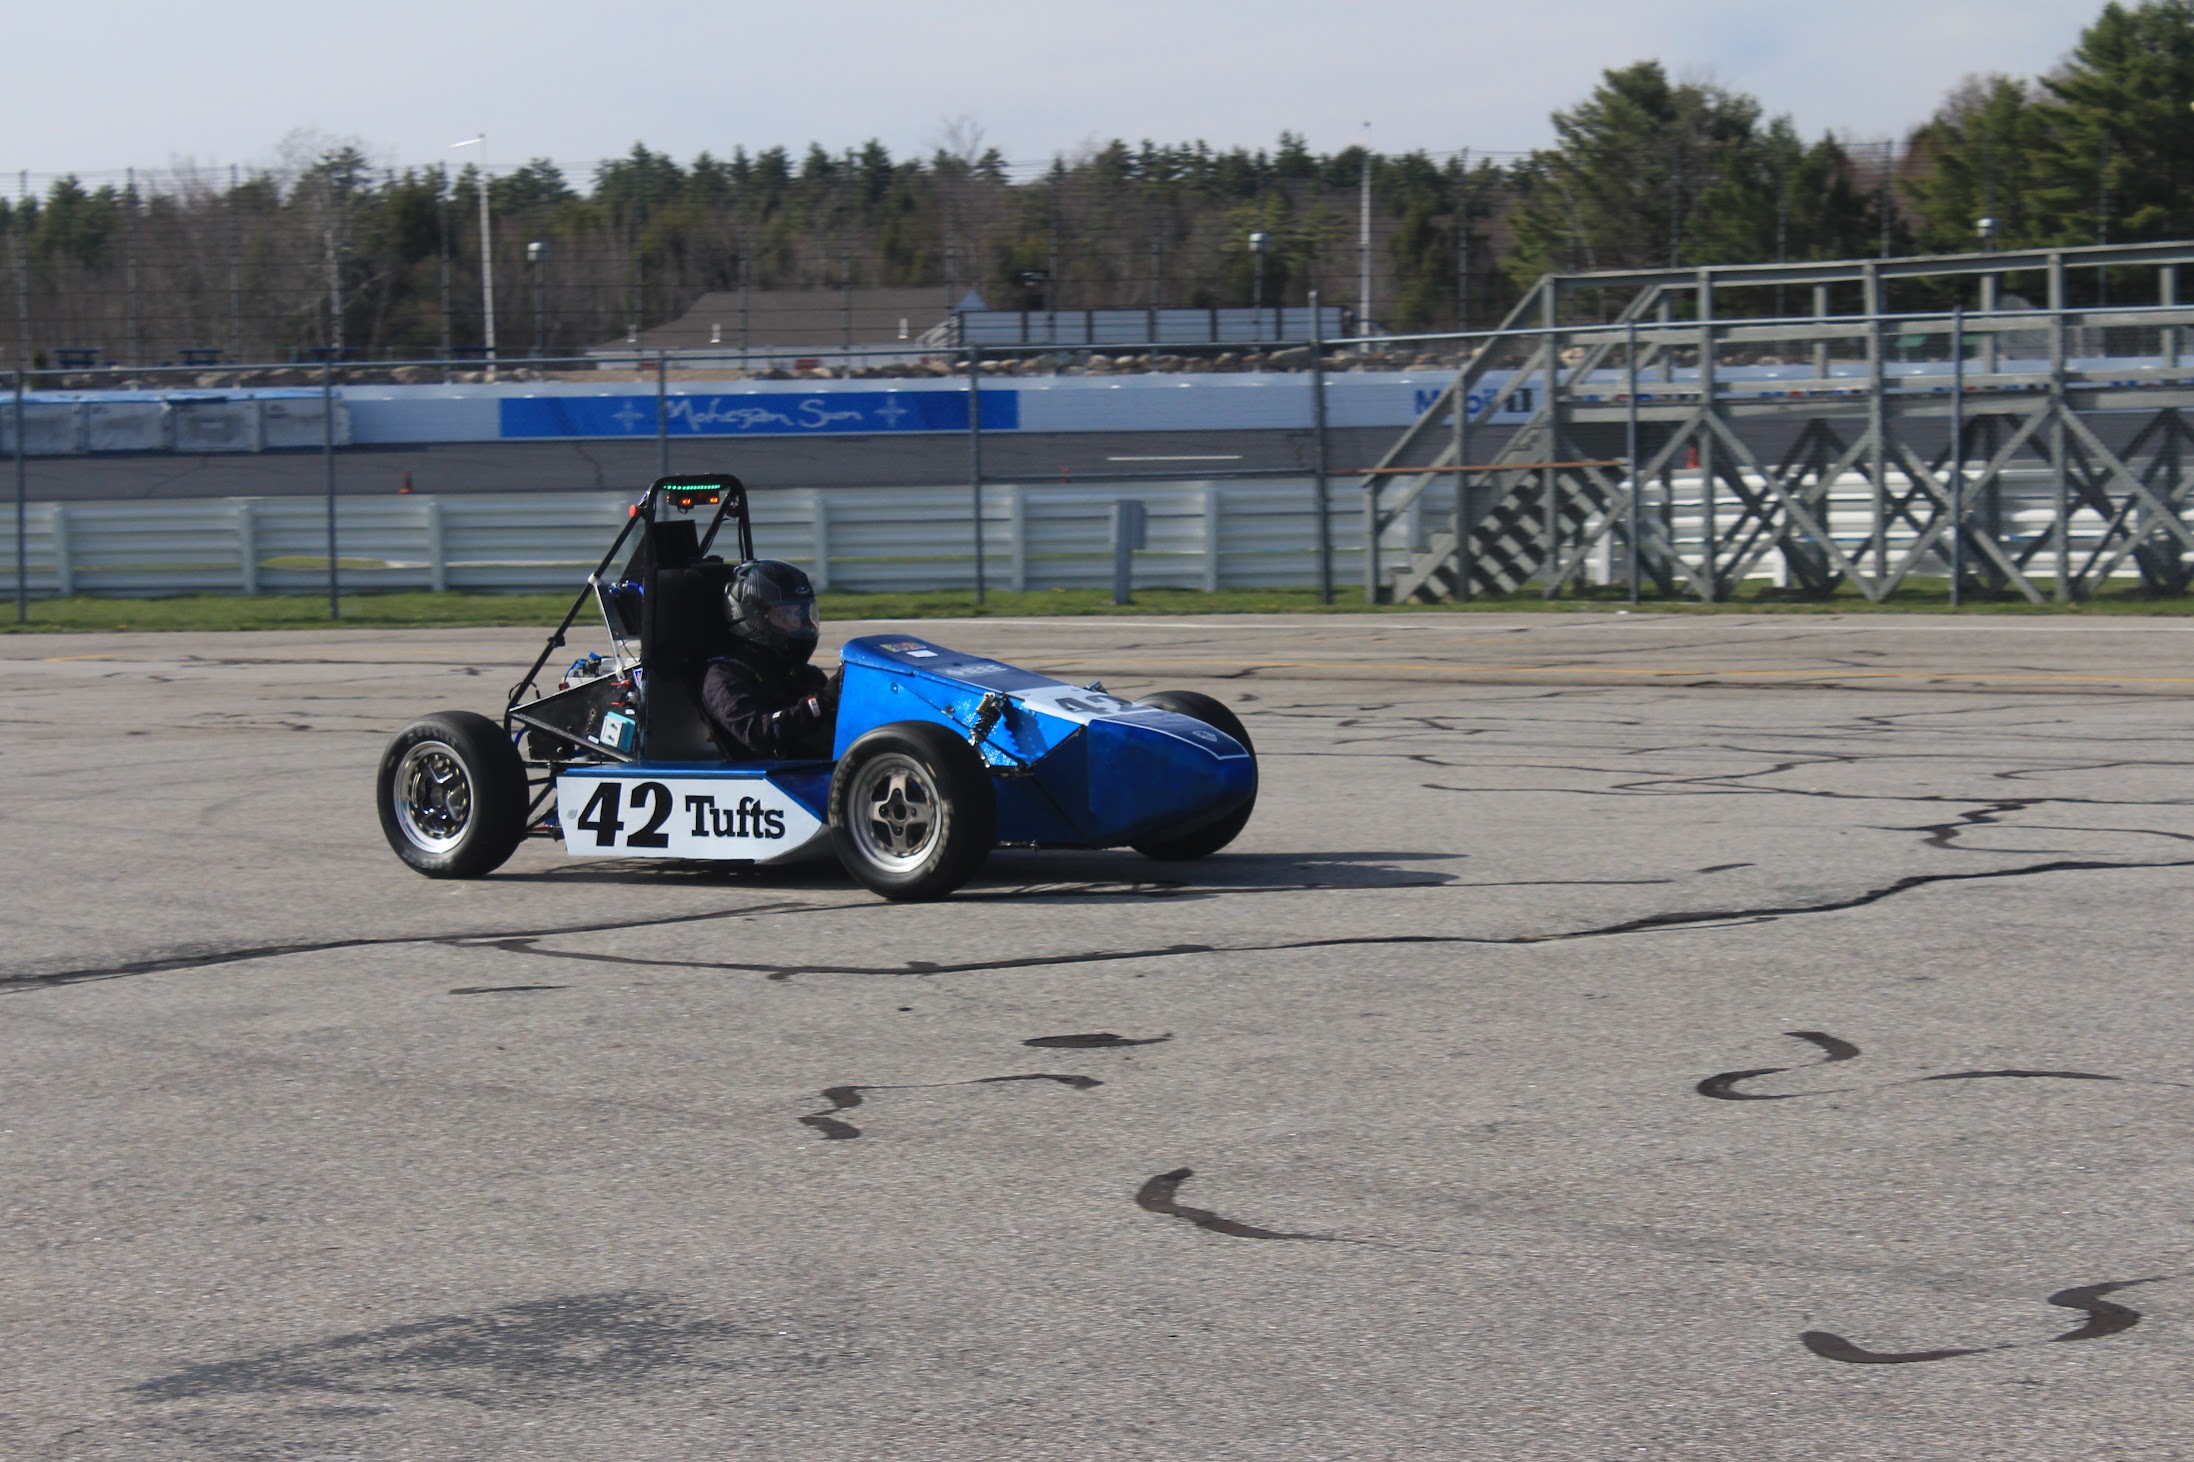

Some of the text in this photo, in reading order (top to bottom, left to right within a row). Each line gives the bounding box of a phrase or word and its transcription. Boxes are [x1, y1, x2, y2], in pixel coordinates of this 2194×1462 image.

[665, 397, 863, 432] Mohegan Sun
[577, 781, 786, 849] 42 Tufts
